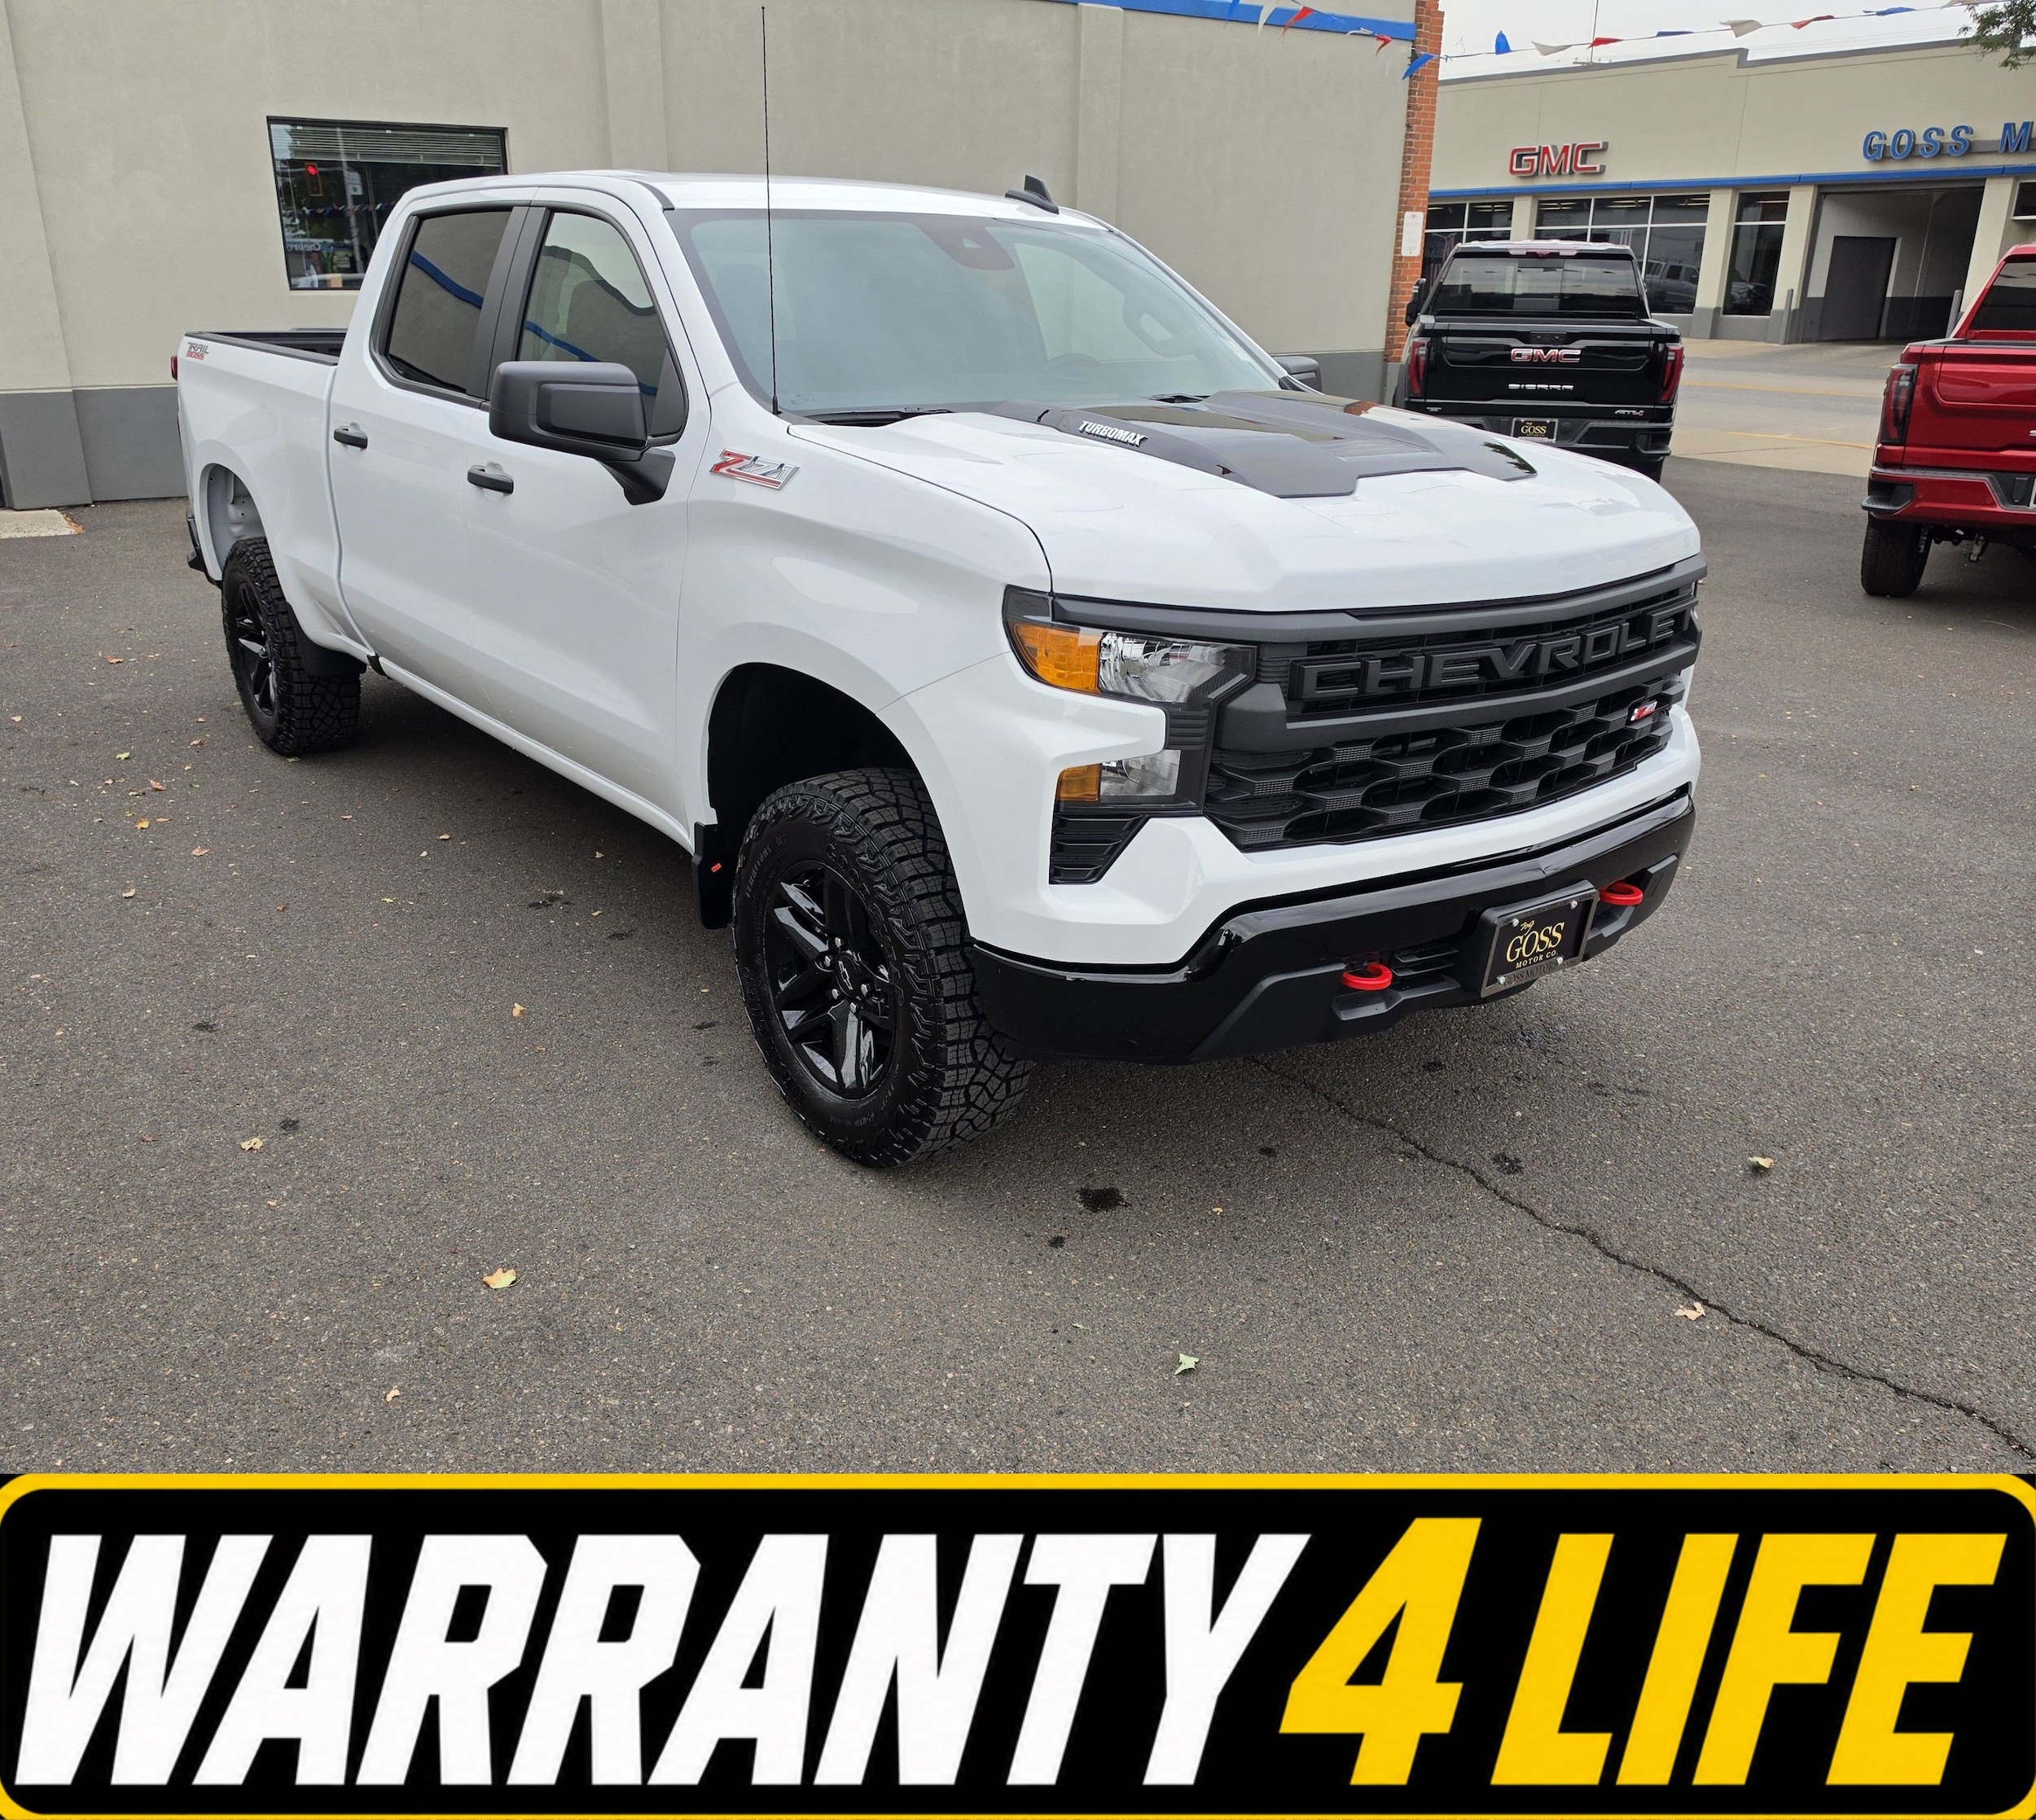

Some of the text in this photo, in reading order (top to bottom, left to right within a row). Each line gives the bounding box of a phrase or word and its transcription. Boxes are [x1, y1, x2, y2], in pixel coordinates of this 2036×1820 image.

[1863, 125, 1974, 161] GOSS
[1509, 142, 1607, 176] GMC
[186, 351, 205, 361] BOSS
[187, 342, 209, 354] TRAIL
[1511, 349, 1581, 362] GMC
[1078, 420, 1148, 448] TURBOMAX
[1520, 425, 1547, 434] GOSS
[709, 449, 800, 490] Z71
[1287, 599, 1699, 699] CHEVROLET
[1506, 922, 1565, 963] GOSS
[1515, 949, 1559, 970] MOTOR CO.
